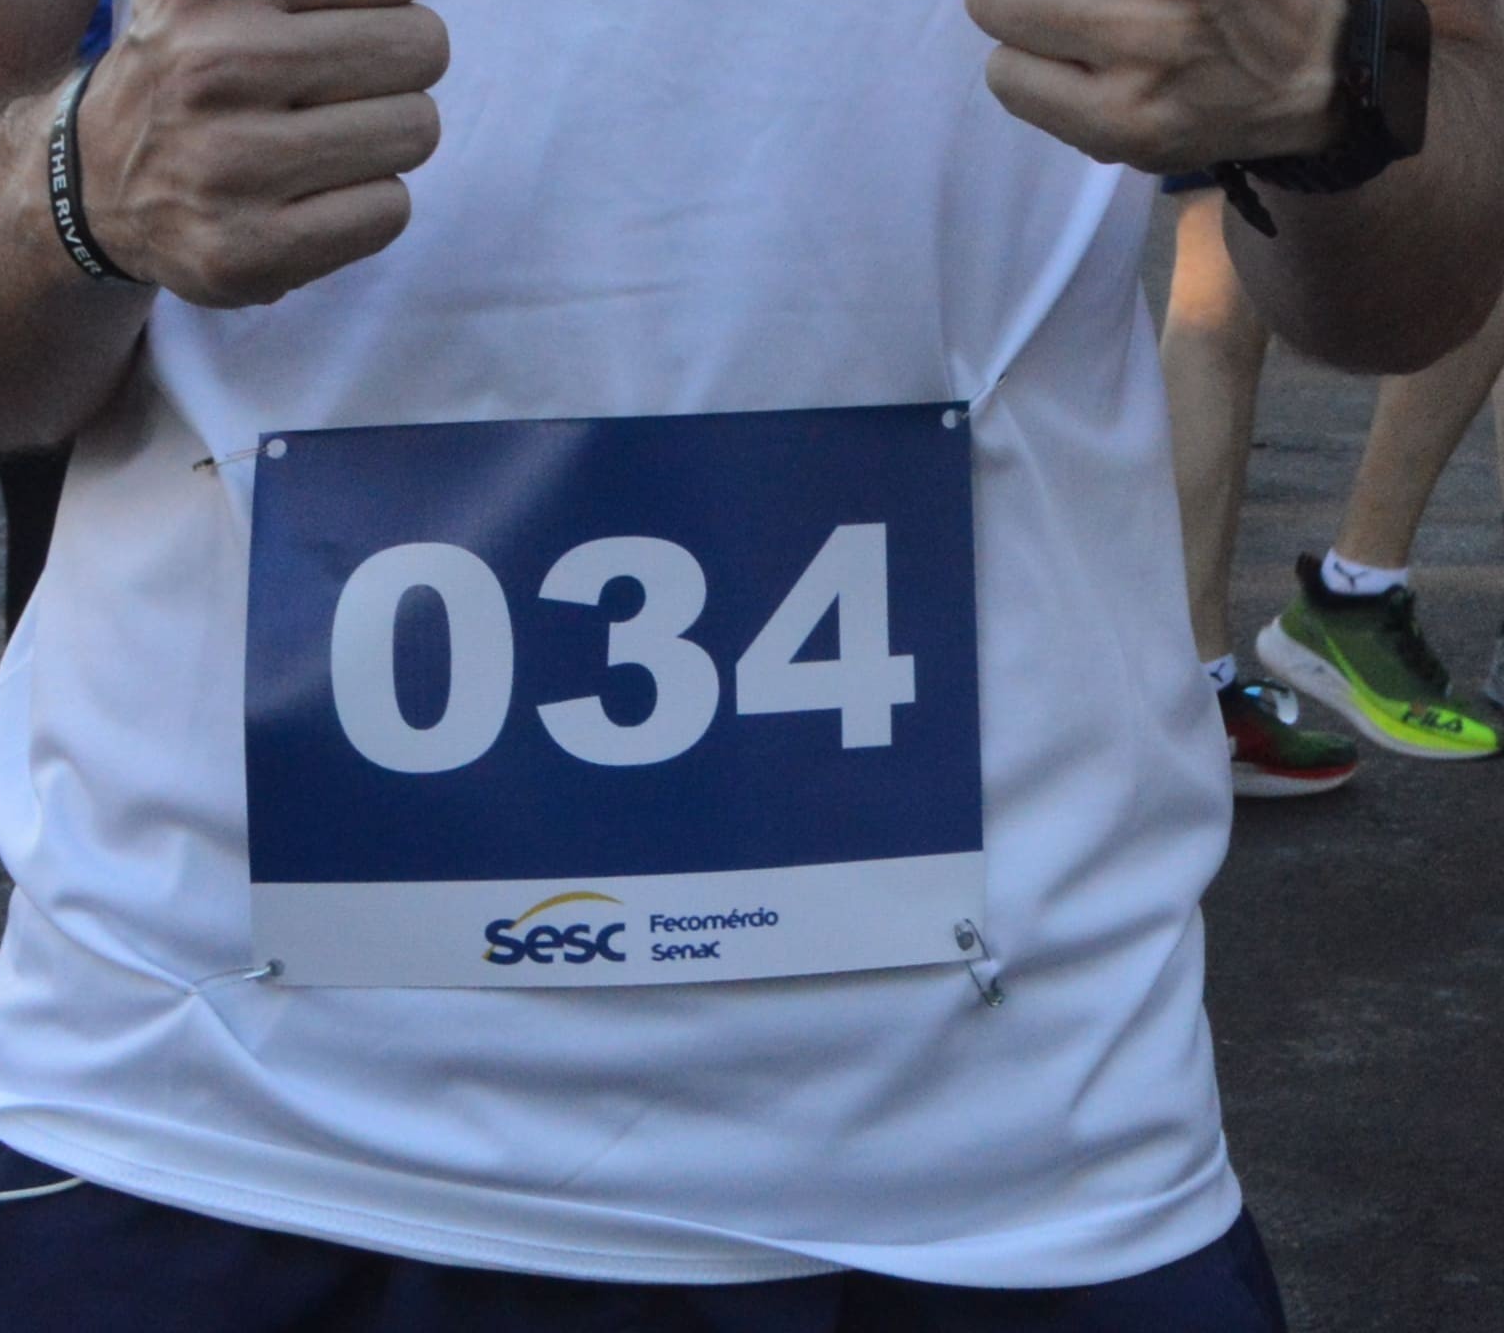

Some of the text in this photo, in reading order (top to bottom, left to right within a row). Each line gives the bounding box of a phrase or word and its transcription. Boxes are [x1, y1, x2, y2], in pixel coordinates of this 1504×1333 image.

[50, 133, 68, 194] THE
[55, 196, 104, 275] RIVER
[329, 521, 917, 776] 034
[650, 906, 779, 933] Fecomércio
